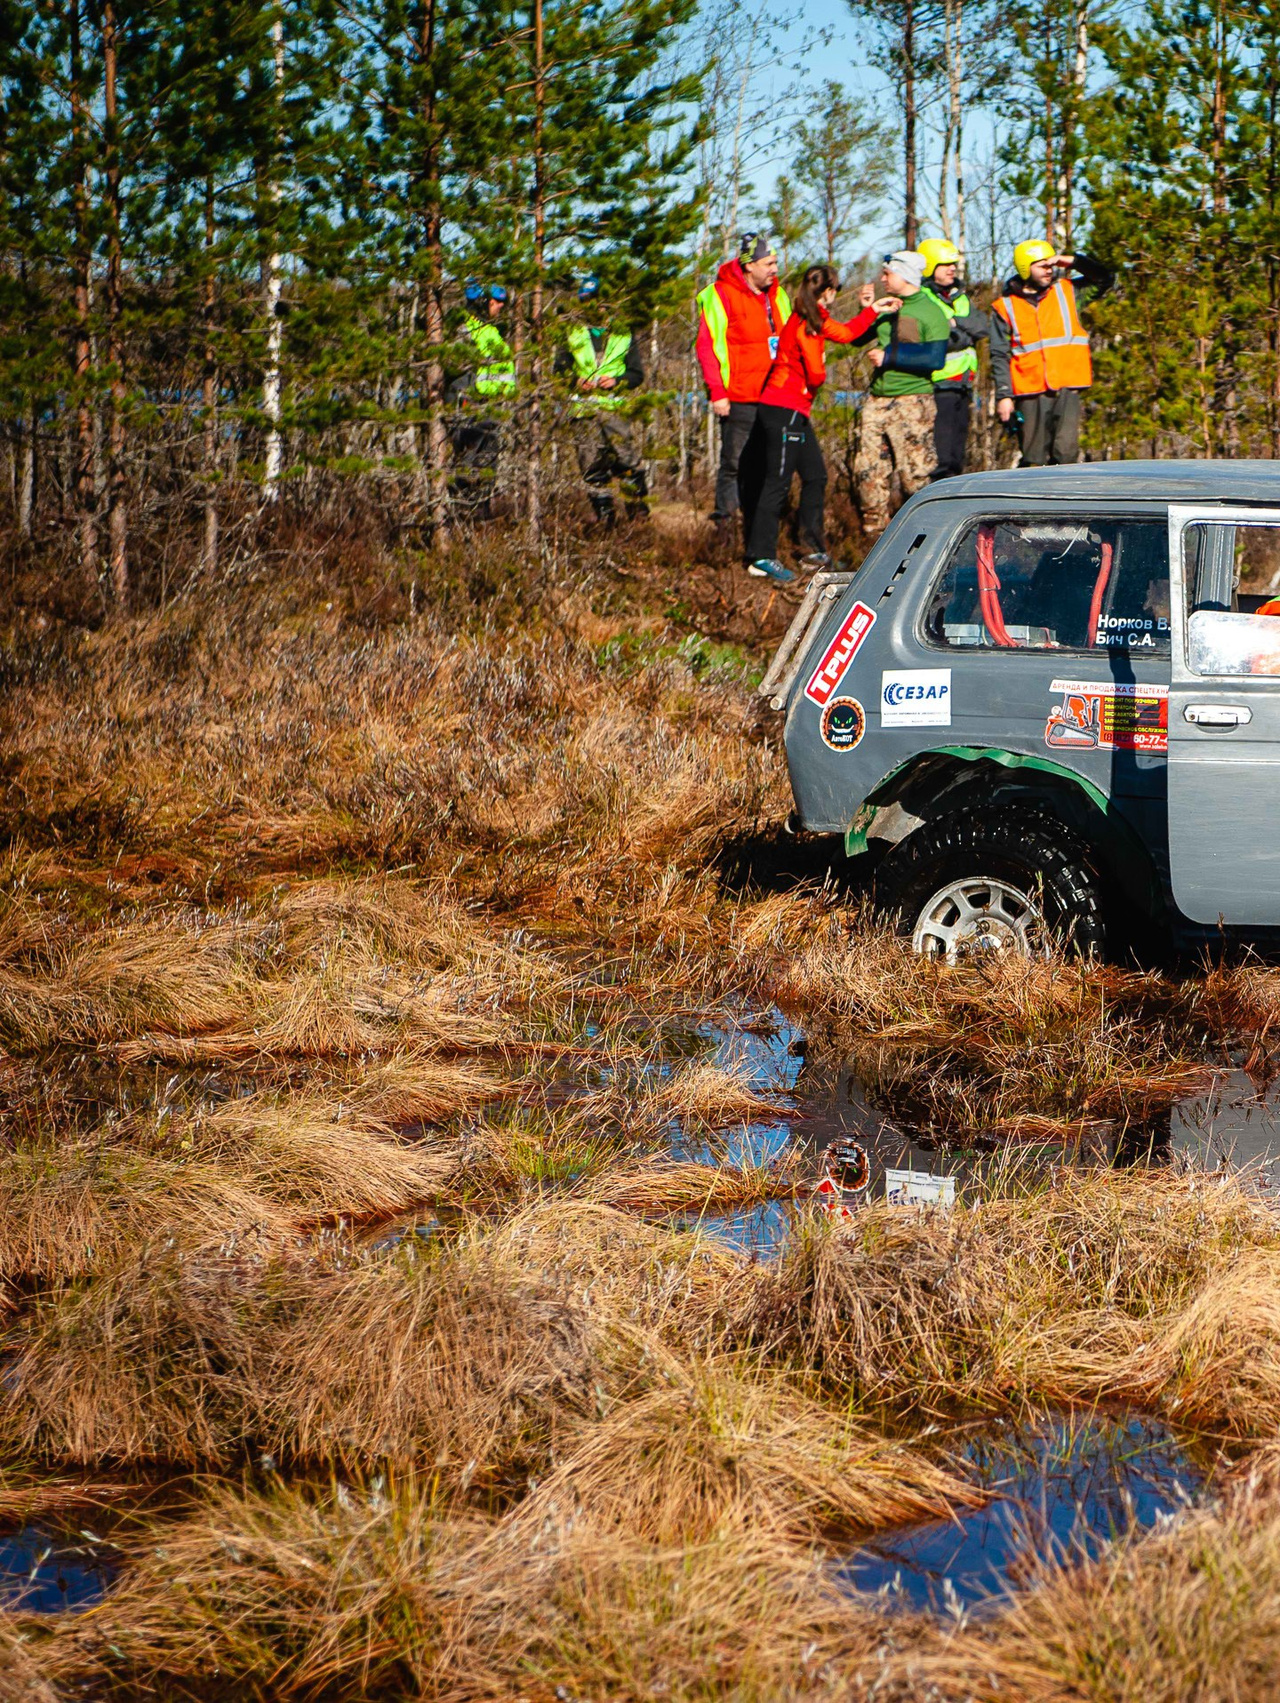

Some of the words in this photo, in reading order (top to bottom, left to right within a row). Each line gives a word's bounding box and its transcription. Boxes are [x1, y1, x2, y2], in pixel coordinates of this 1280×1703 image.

[1097, 614, 1153, 631] Норков
[1157, 617, 1172, 631] В.
[1095, 631, 1123, 645] Бич
[1127, 633, 1156, 646] С.А.
[810, 612, 870, 694] TPLUS
[896, 686, 948, 700] СЕЗАР
[1052, 683, 1081, 692] АРЕНДА
[1090, 685, 1127, 693] ПРОДАЖА
